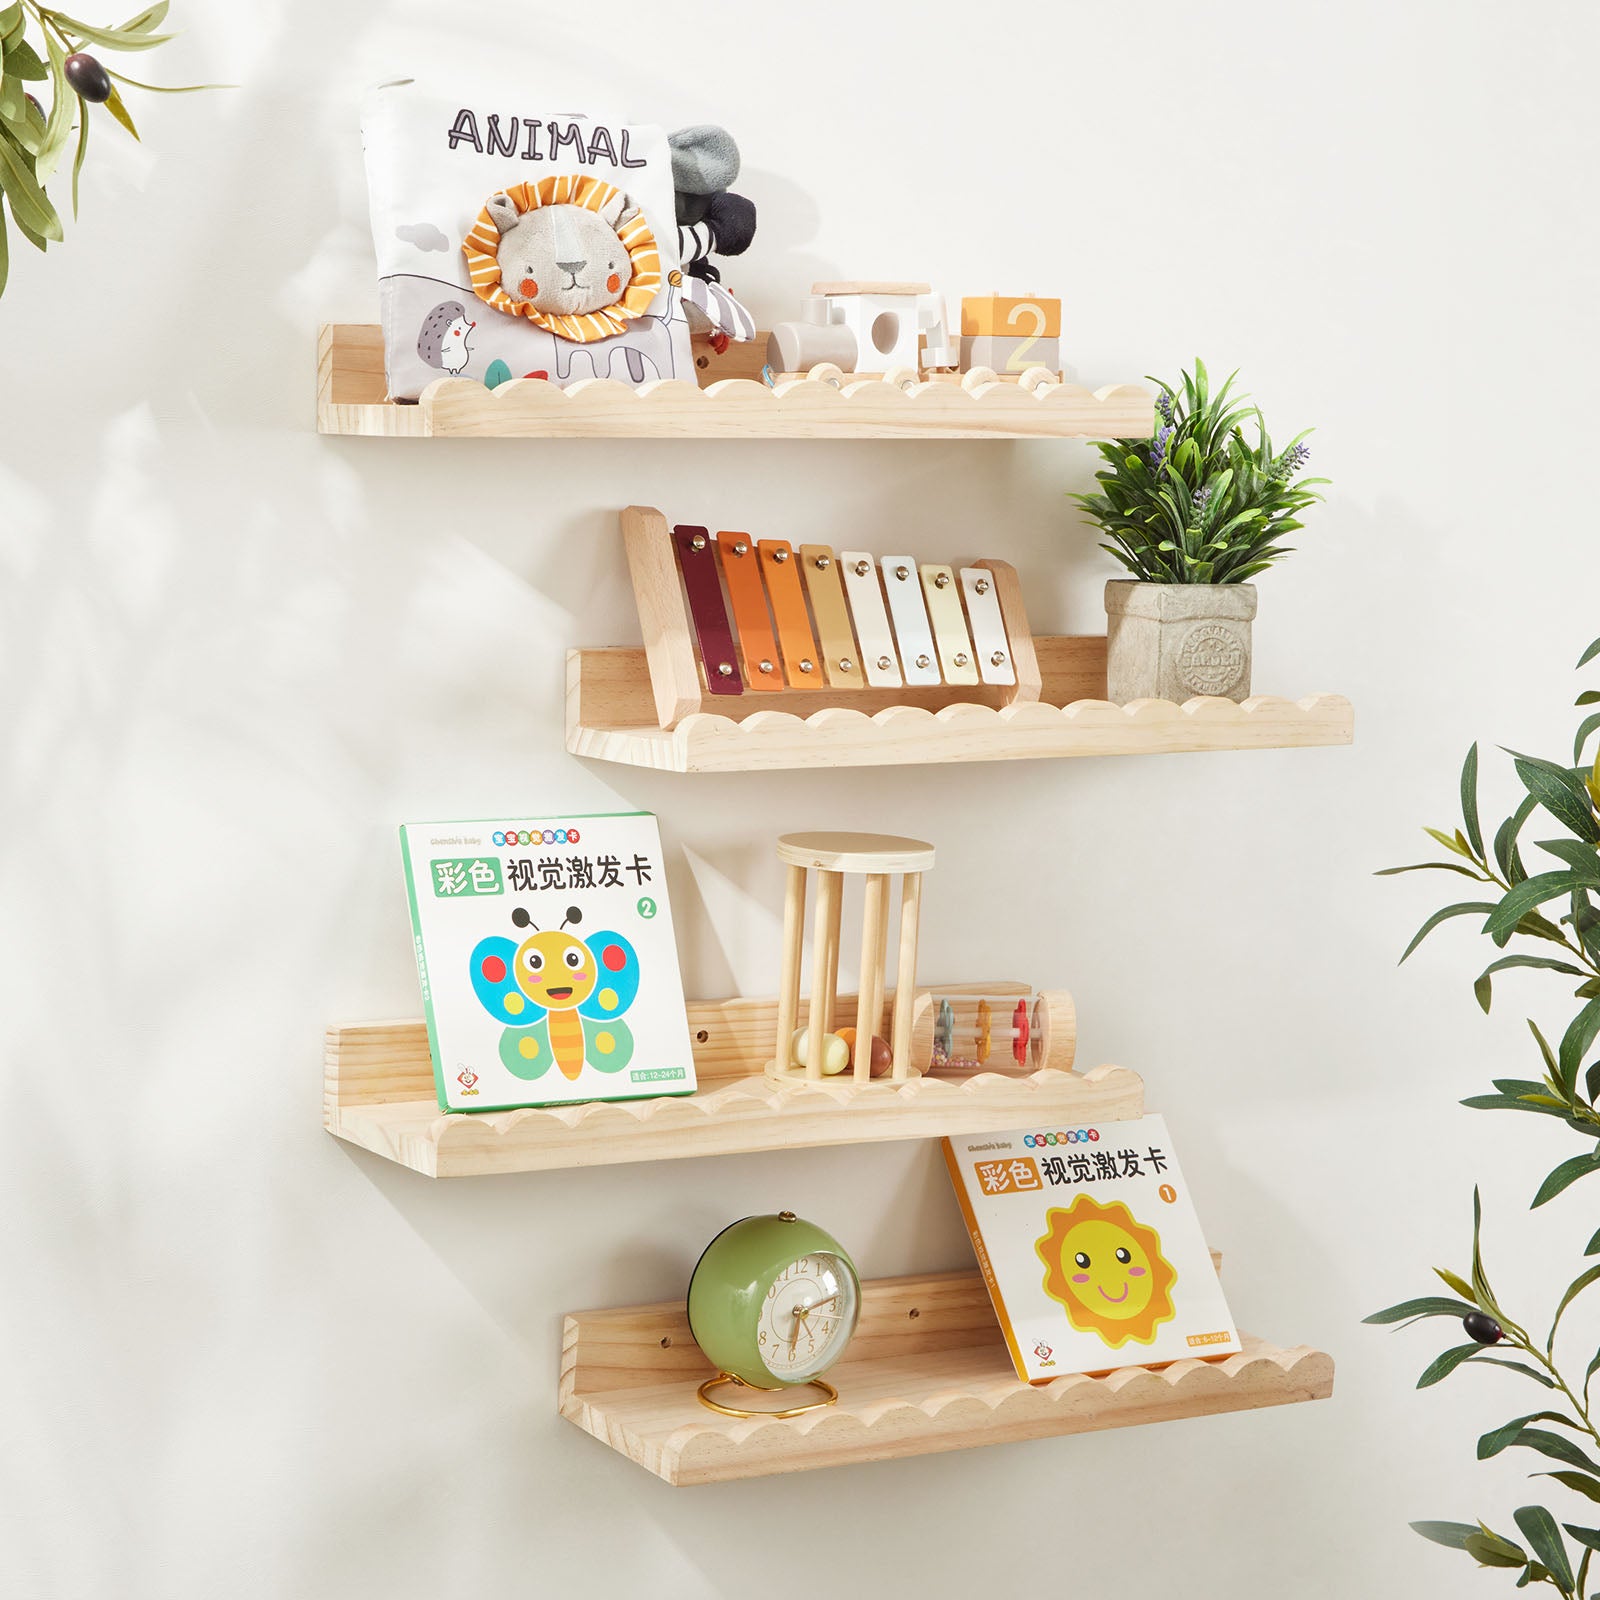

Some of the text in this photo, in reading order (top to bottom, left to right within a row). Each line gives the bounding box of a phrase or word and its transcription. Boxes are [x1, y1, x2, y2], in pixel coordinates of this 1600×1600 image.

[448, 108, 647, 168] ANIMAL
[1006, 303, 1046, 371] 2
[435, 854, 652, 895] 彩色 视觉激发卡
[641, 900, 653, 917] 2
[980, 1147, 1168, 1193] 彩色 视觉激发卡
[1163, 1187, 1172, 1201] 1
[794, 1258, 809, 1275] 12
[815, 1263, 822, 1277] 1
[828, 1297, 837, 1312] 3
[821, 1320, 830, 1335] 4
[758, 1331, 767, 1346] 8
[771, 1344, 780, 1359] 7
[807, 1339, 816, 1354] 5
[788, 1347, 796, 1362] 6
